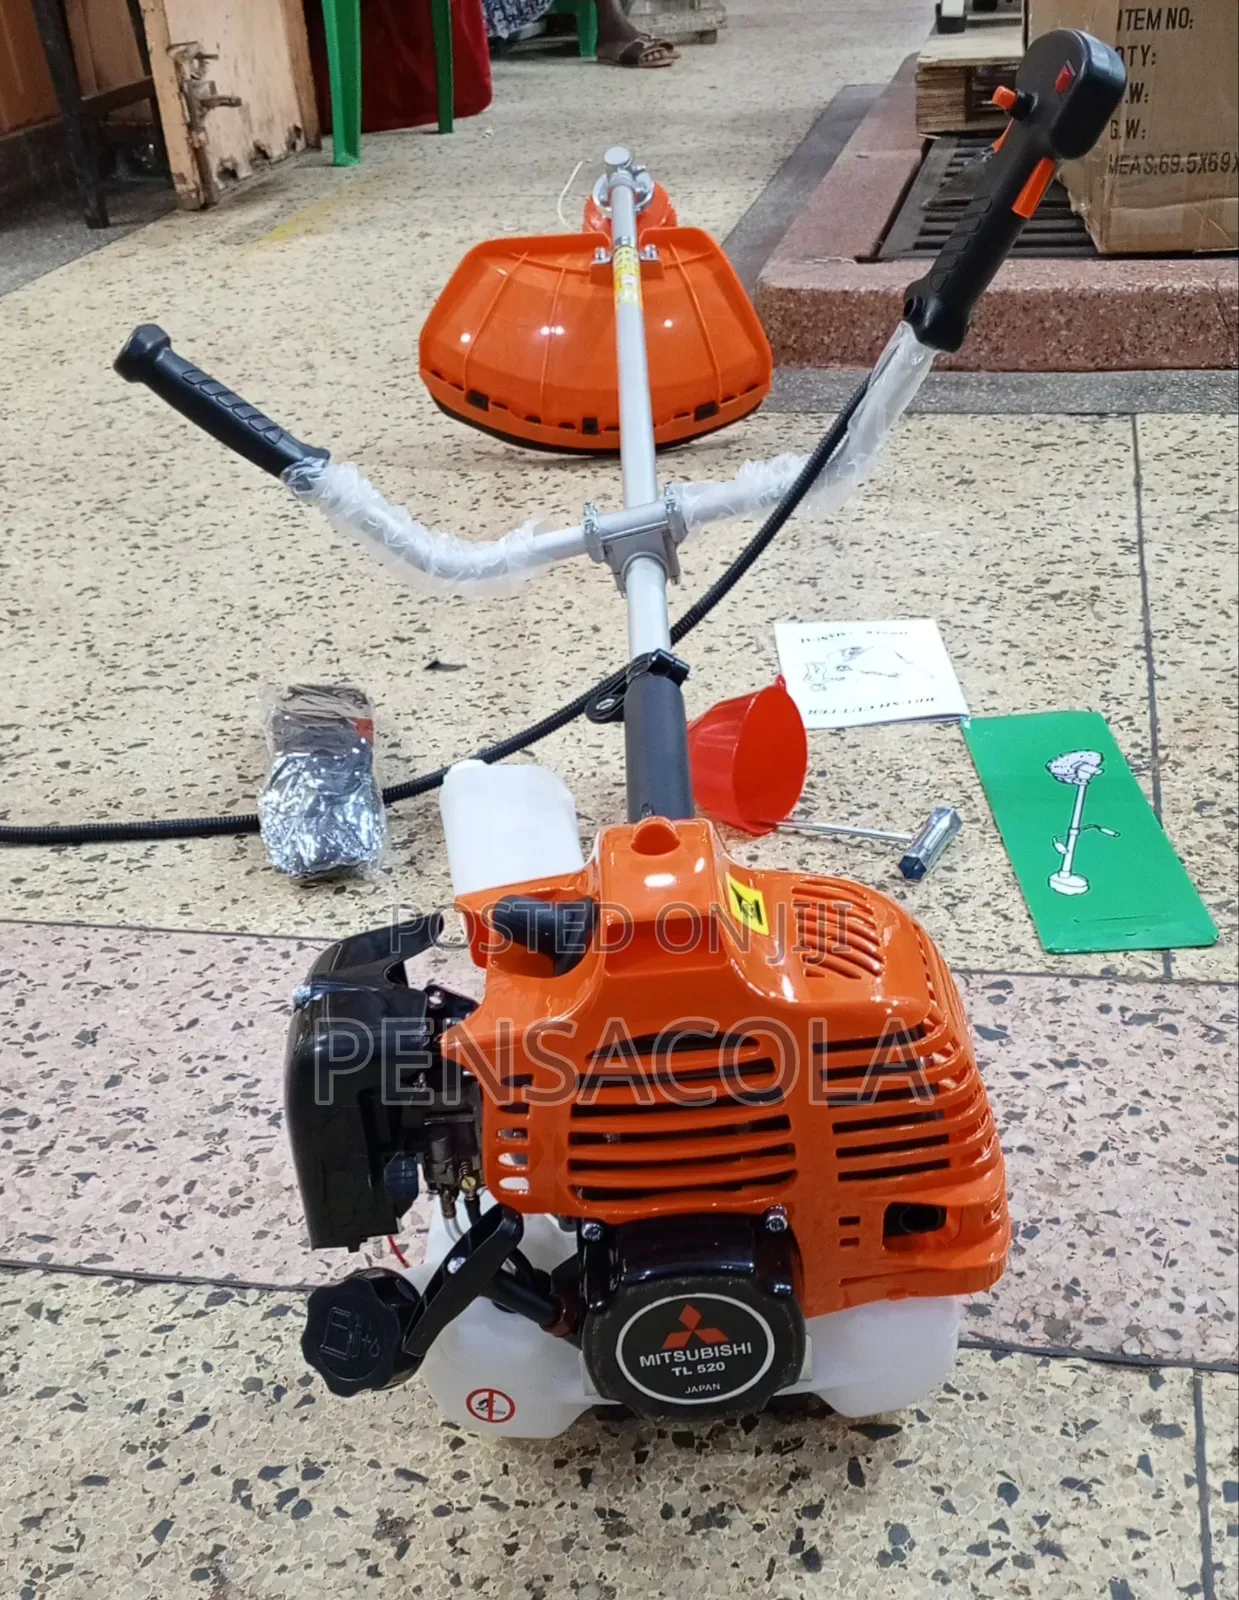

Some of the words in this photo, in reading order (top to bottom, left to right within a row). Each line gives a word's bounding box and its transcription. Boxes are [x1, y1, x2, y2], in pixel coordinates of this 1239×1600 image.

[1117, 8, 1162, 31] ITEM
[1165, 7, 1194, 30] NO:
[1120, 82, 1150, 104] .W:
[639, 1342, 753, 1368] MITSUBISHI
[671, 1366, 693, 1377] TL
[697, 1361, 726, 1374] 520
[685, 1383, 721, 1394] JAPAN
